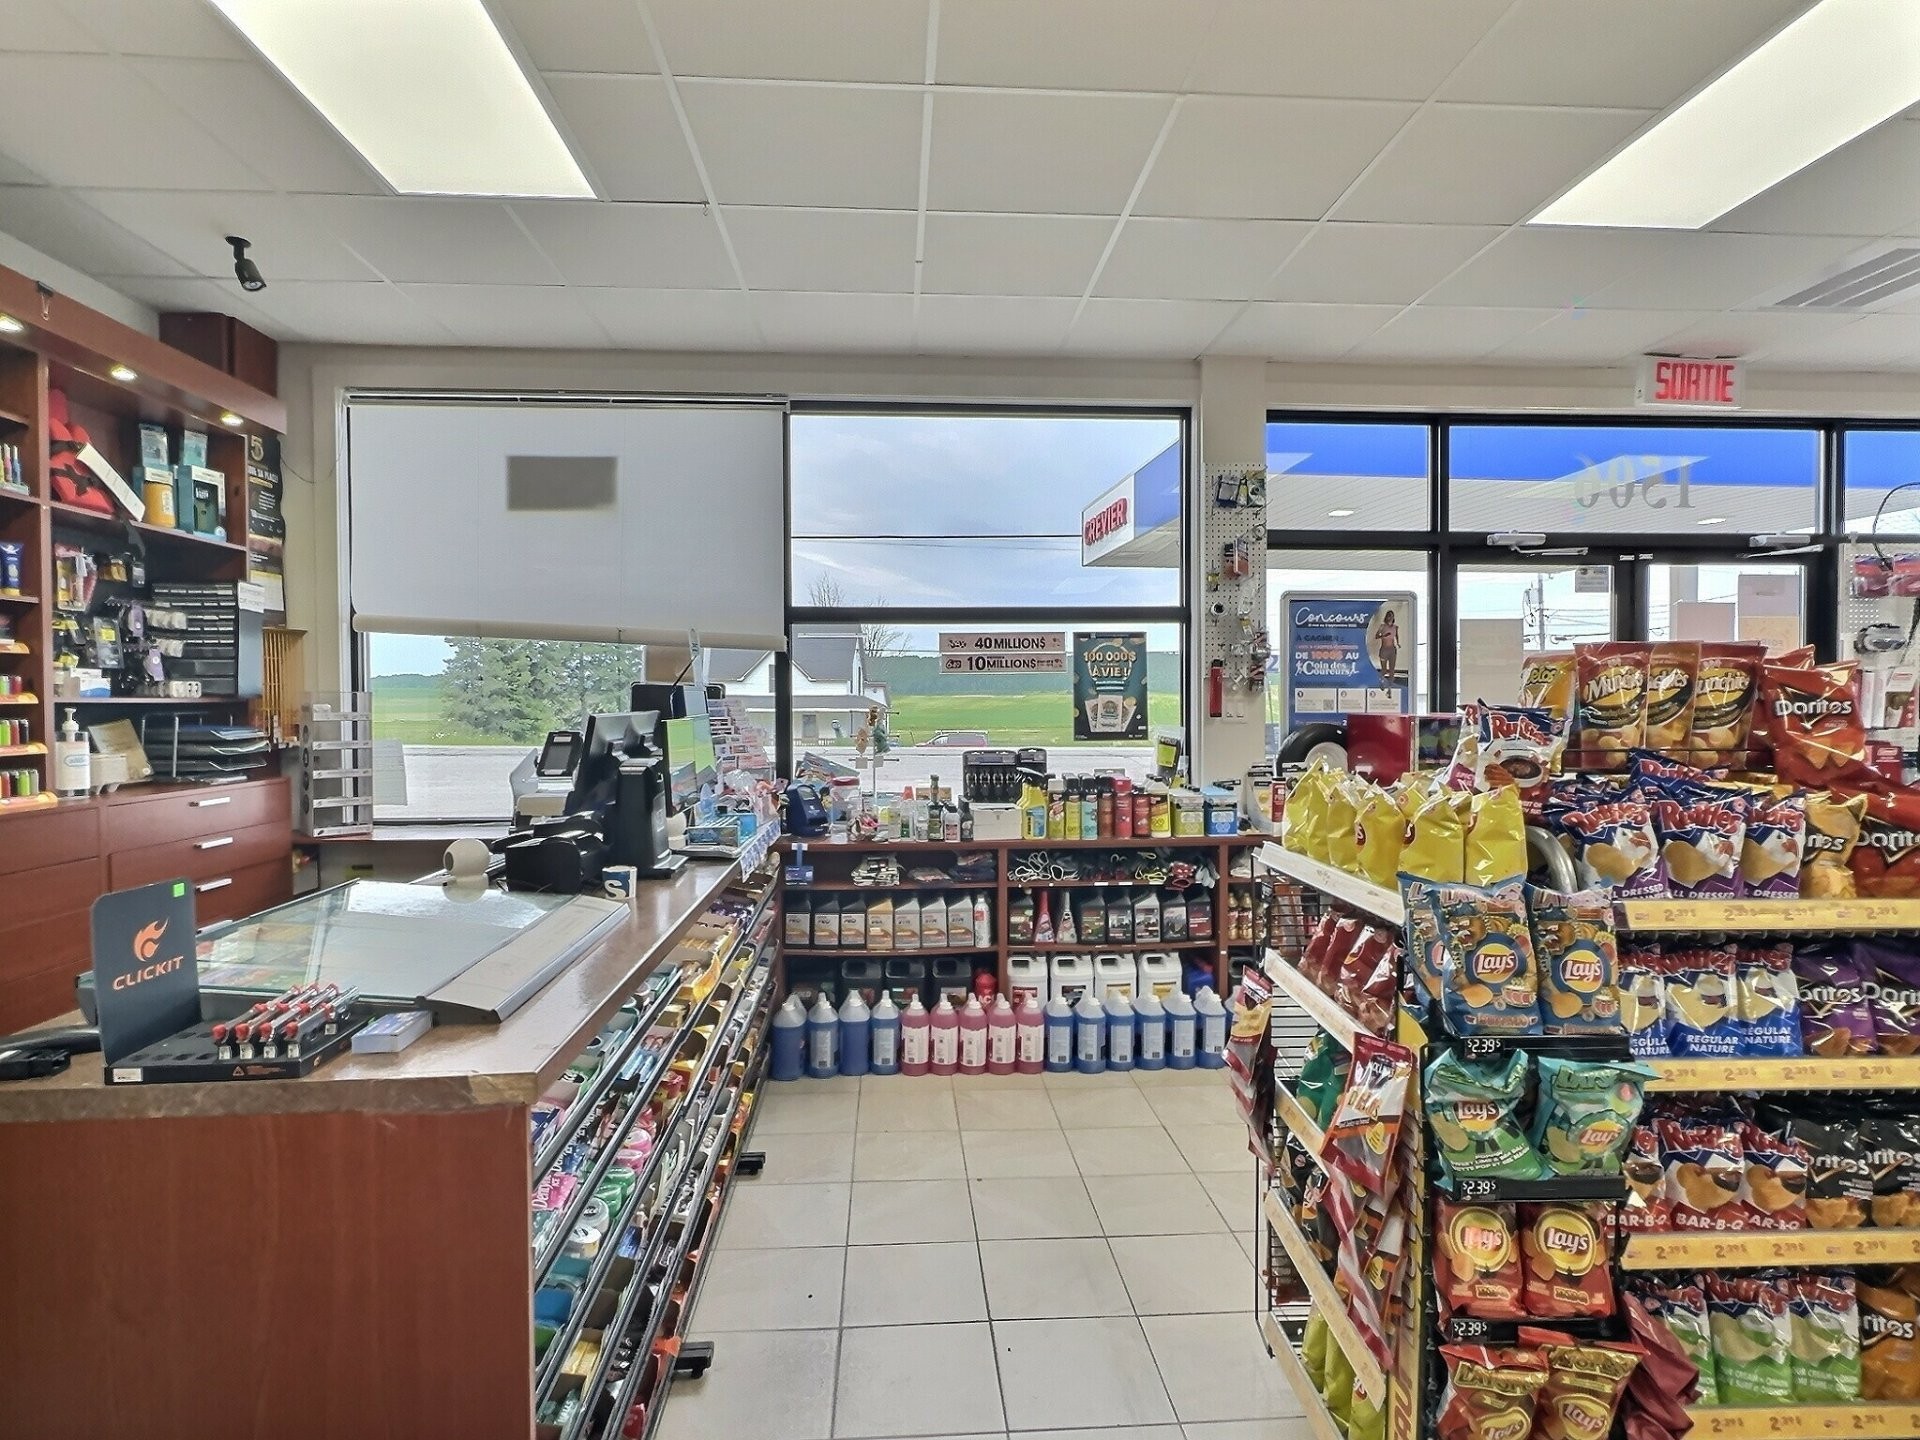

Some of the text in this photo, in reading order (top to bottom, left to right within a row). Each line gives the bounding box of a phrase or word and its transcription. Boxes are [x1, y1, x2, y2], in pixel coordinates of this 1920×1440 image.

[1655, 362, 1735, 402] SORTIE
[1085, 498, 1128, 546] CREVIER
[1295, 607, 1368, 626] Concours
[975, 637, 992, 649] 40
[967, 656, 986, 670] 10
[1084, 652, 1102, 661] 100
[1295, 652, 1308, 660] DE
[1345, 652, 1359, 660] AU
[1101, 667, 1122, 677] VIE
[1698, 674, 1749, 692] unchies
[1775, 700, 1852, 716] Doritos
[1650, 800, 1745, 836] Ruffles
[1621, 884, 1664, 897] DRESSED
[1753, 889, 1800, 898] DRESSED
[113, 955, 184, 990] CLICKIT
[1686, 1034, 1739, 1046] REGULAR
[1744, 1034, 1792, 1045] NATURE
[1689, 1043, 1735, 1054] NATURE
[1675, 1212, 1744, 1231] BAR-B-Q
[1750, 1214, 1800, 1231] AR-B-Q
[1862, 1314, 1915, 1339] ritos
